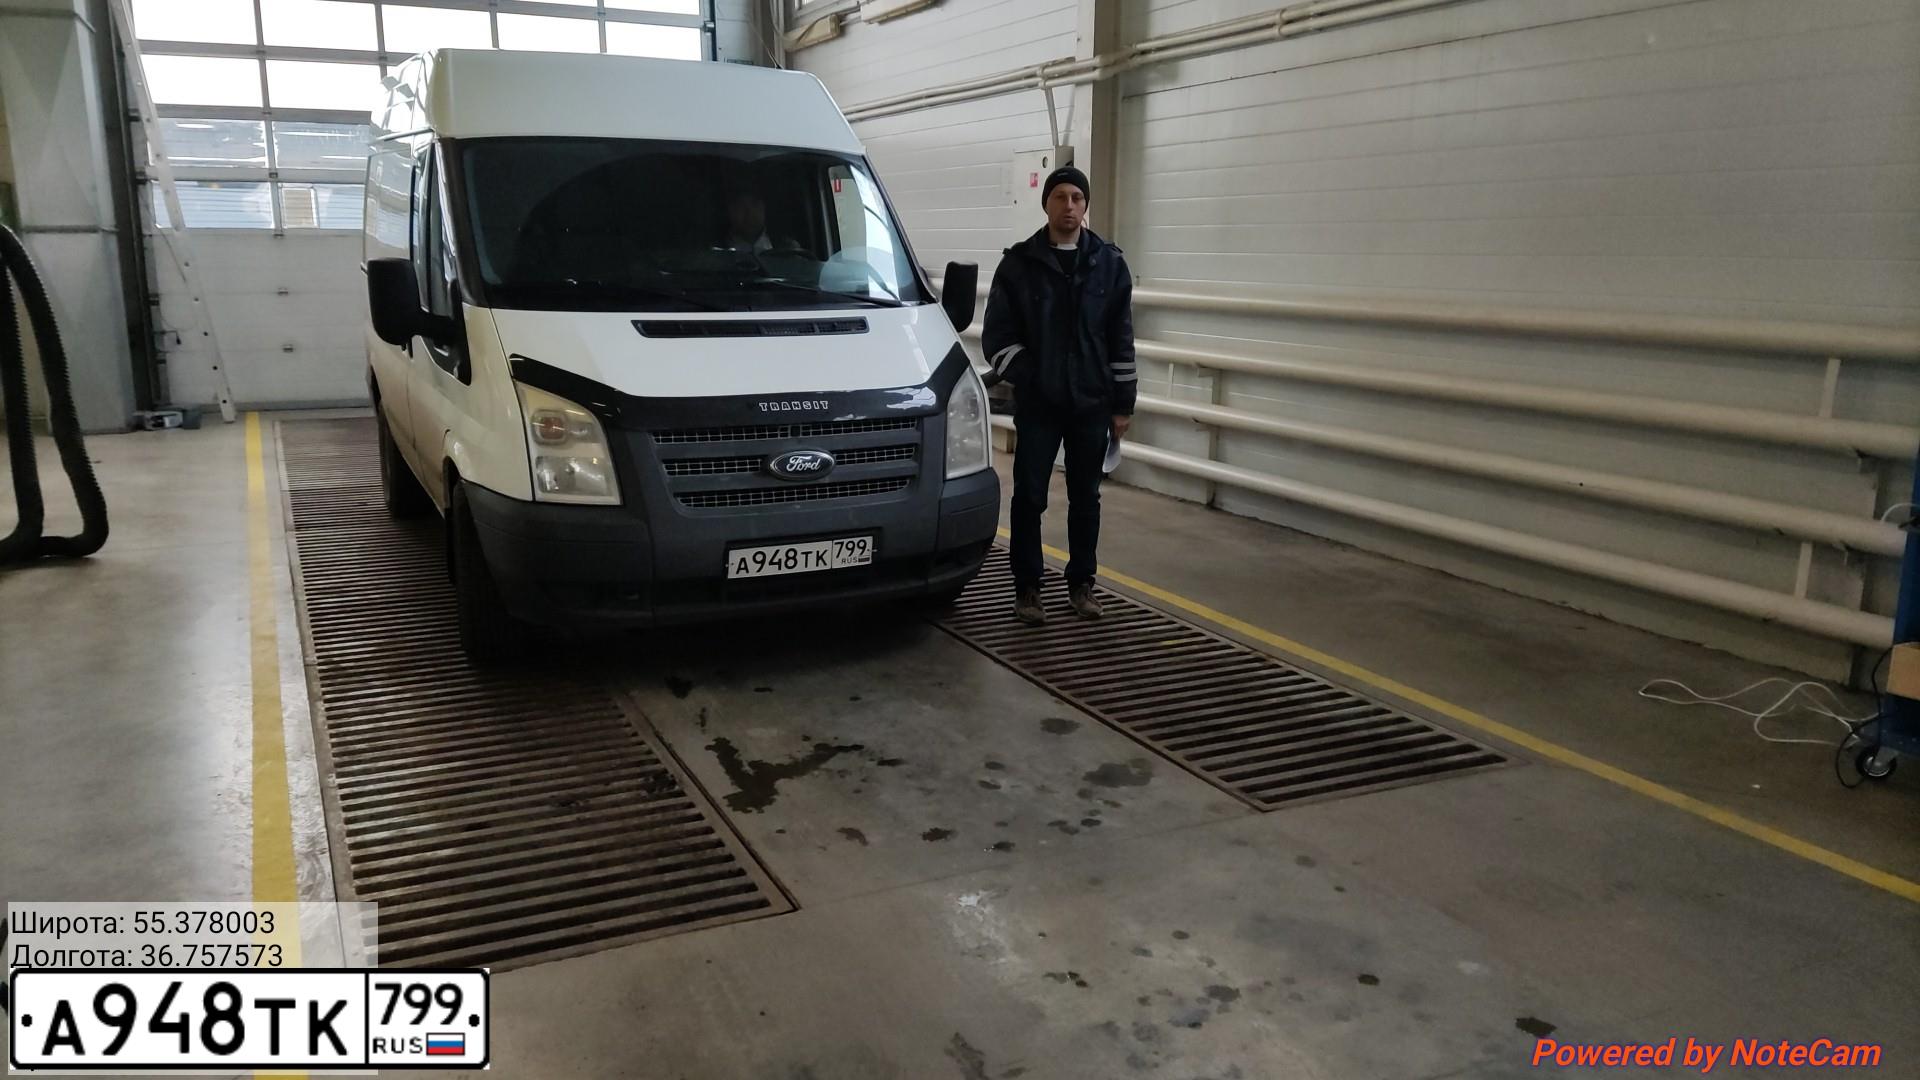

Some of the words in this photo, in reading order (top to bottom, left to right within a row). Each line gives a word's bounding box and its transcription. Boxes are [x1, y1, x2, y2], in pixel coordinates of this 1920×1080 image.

[759, 401, 829, 412] TRANSIT
[786, 455, 821, 472] Ford
[834, 538, 868, 559] 799
[841, 556, 858, 565] RUS
